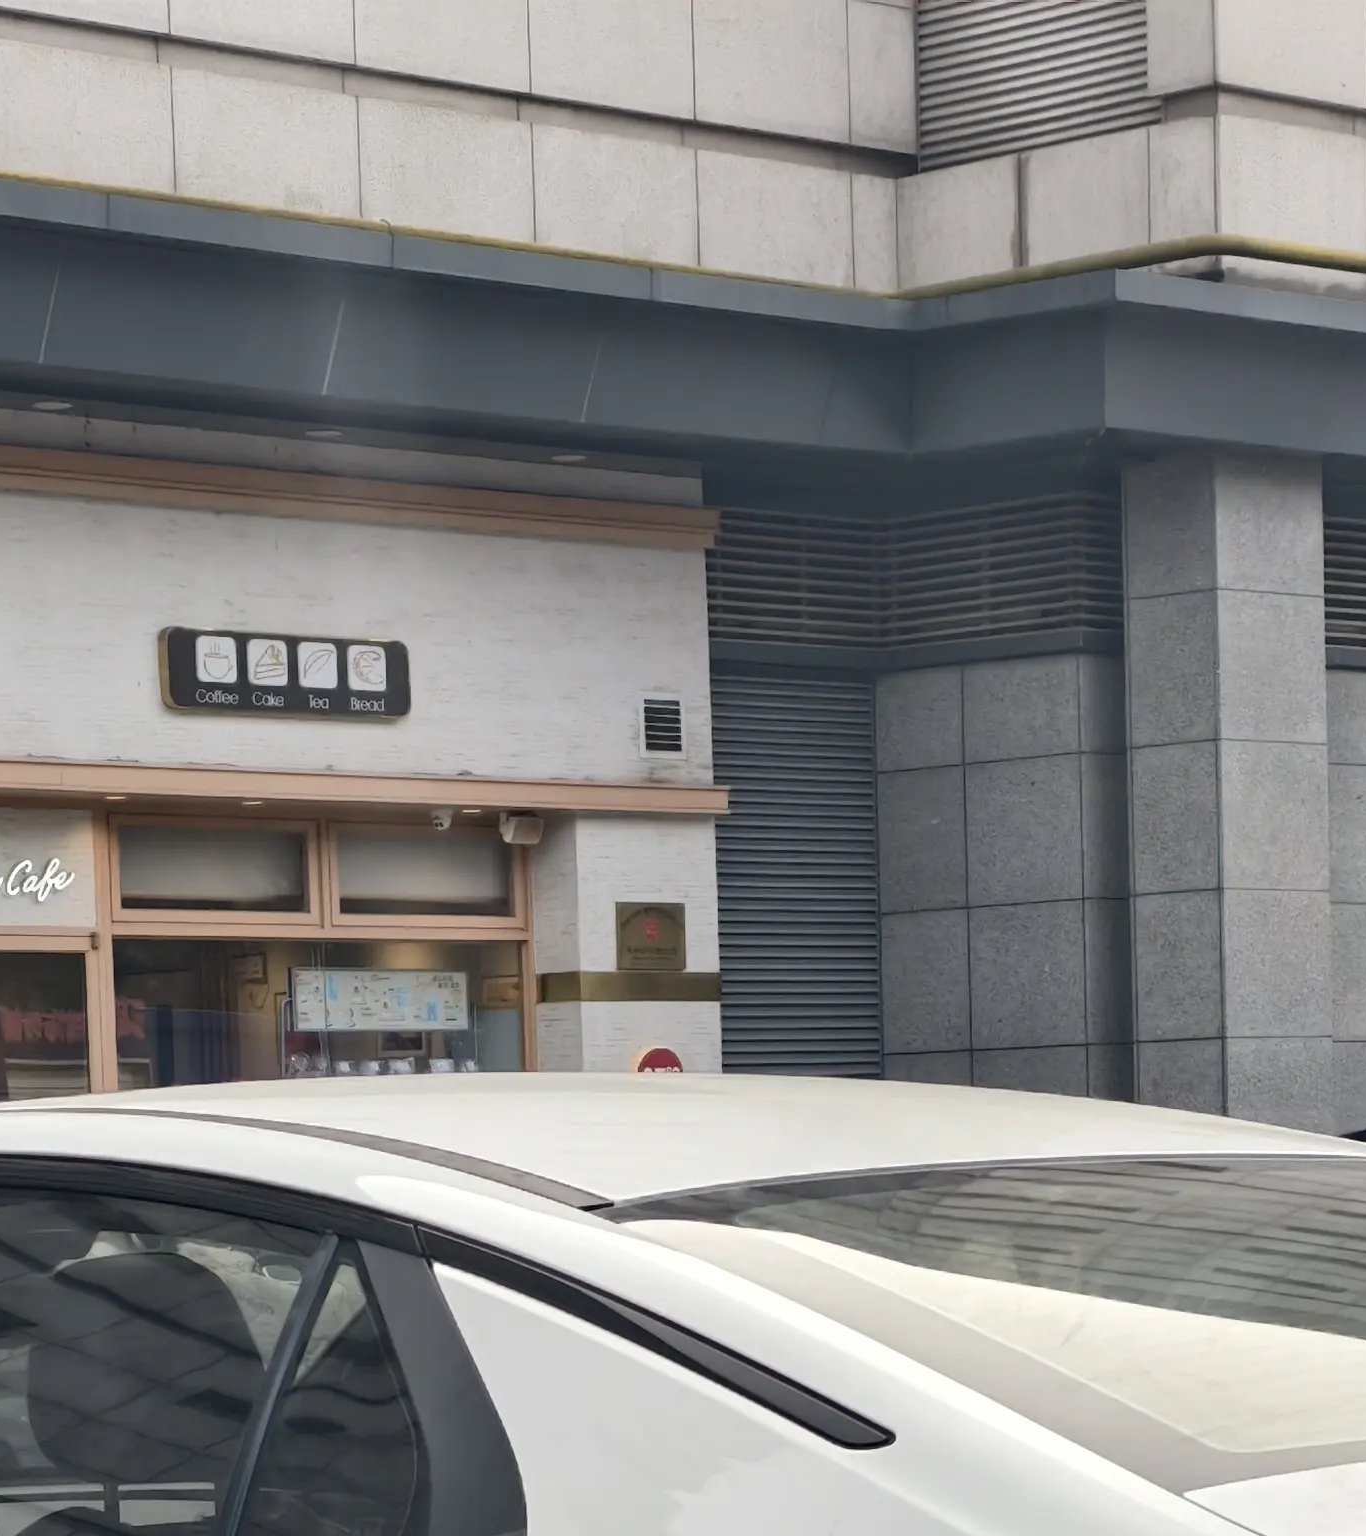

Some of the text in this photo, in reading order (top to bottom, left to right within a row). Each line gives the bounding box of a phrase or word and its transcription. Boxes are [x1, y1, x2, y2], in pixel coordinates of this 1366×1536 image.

[196, 688, 386, 712] Coffee Cake Tea Bread
[6, 857, 75, 902] Cafe
